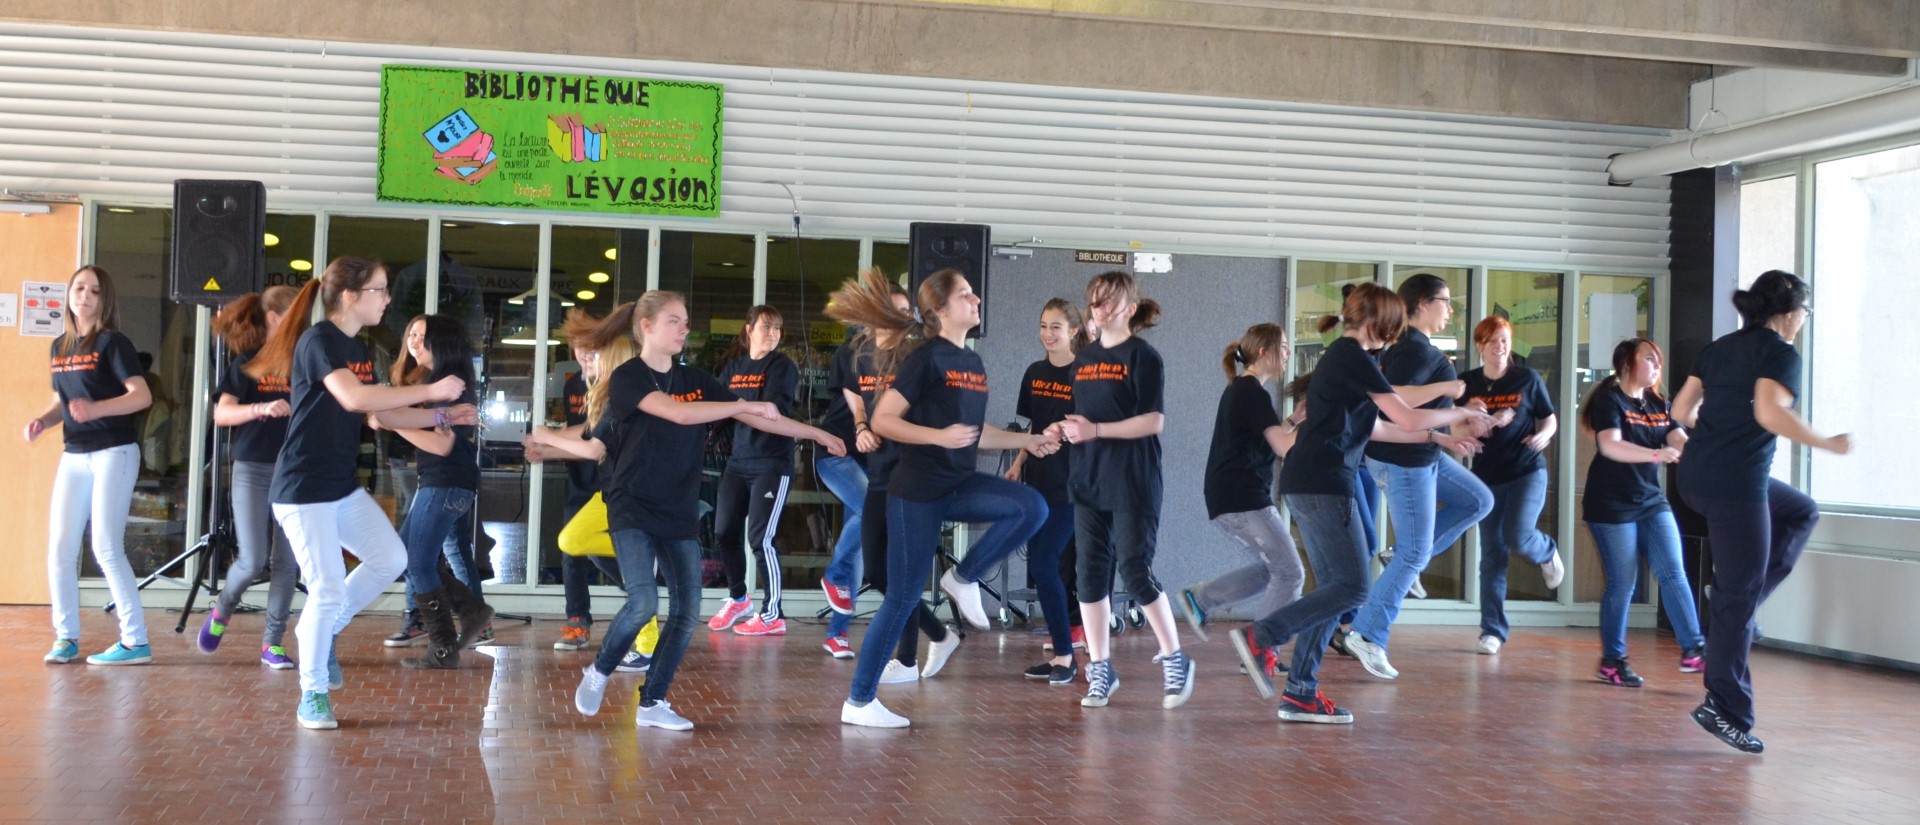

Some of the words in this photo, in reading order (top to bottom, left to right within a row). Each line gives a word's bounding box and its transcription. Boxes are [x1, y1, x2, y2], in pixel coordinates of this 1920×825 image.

[1078, 252, 1124, 263] BIBLIOTHEQUE
[811, 326, 845, 341] Beaux
[1052, 381, 1072, 393] hop
